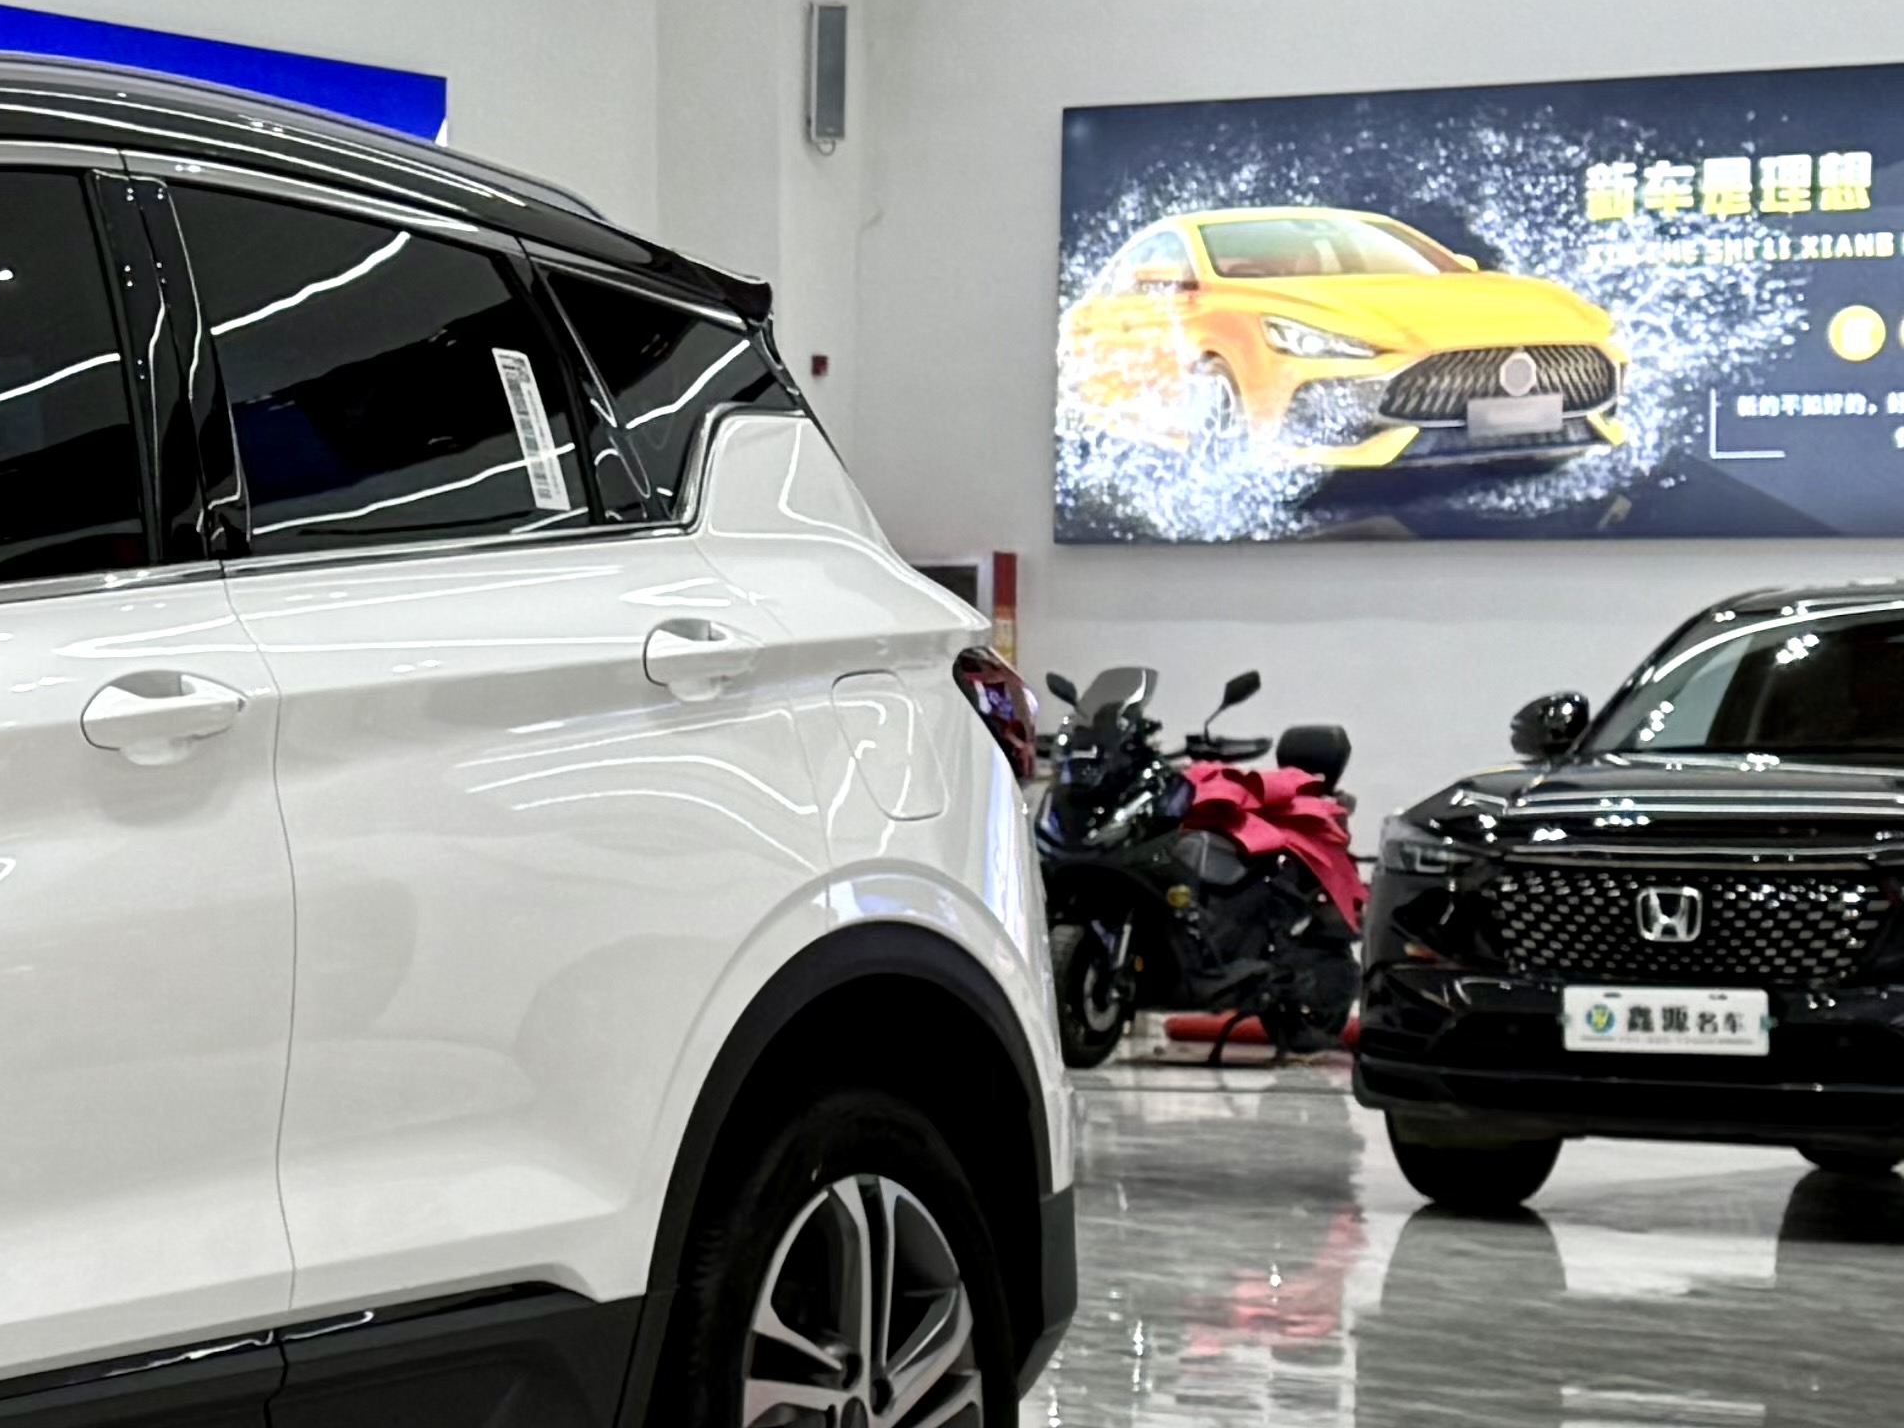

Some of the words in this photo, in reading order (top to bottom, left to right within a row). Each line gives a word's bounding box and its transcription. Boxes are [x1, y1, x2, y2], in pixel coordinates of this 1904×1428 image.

[1585, 151, 1872, 220] 新车是理想
[1800, 232, 1894, 259] XIANG
